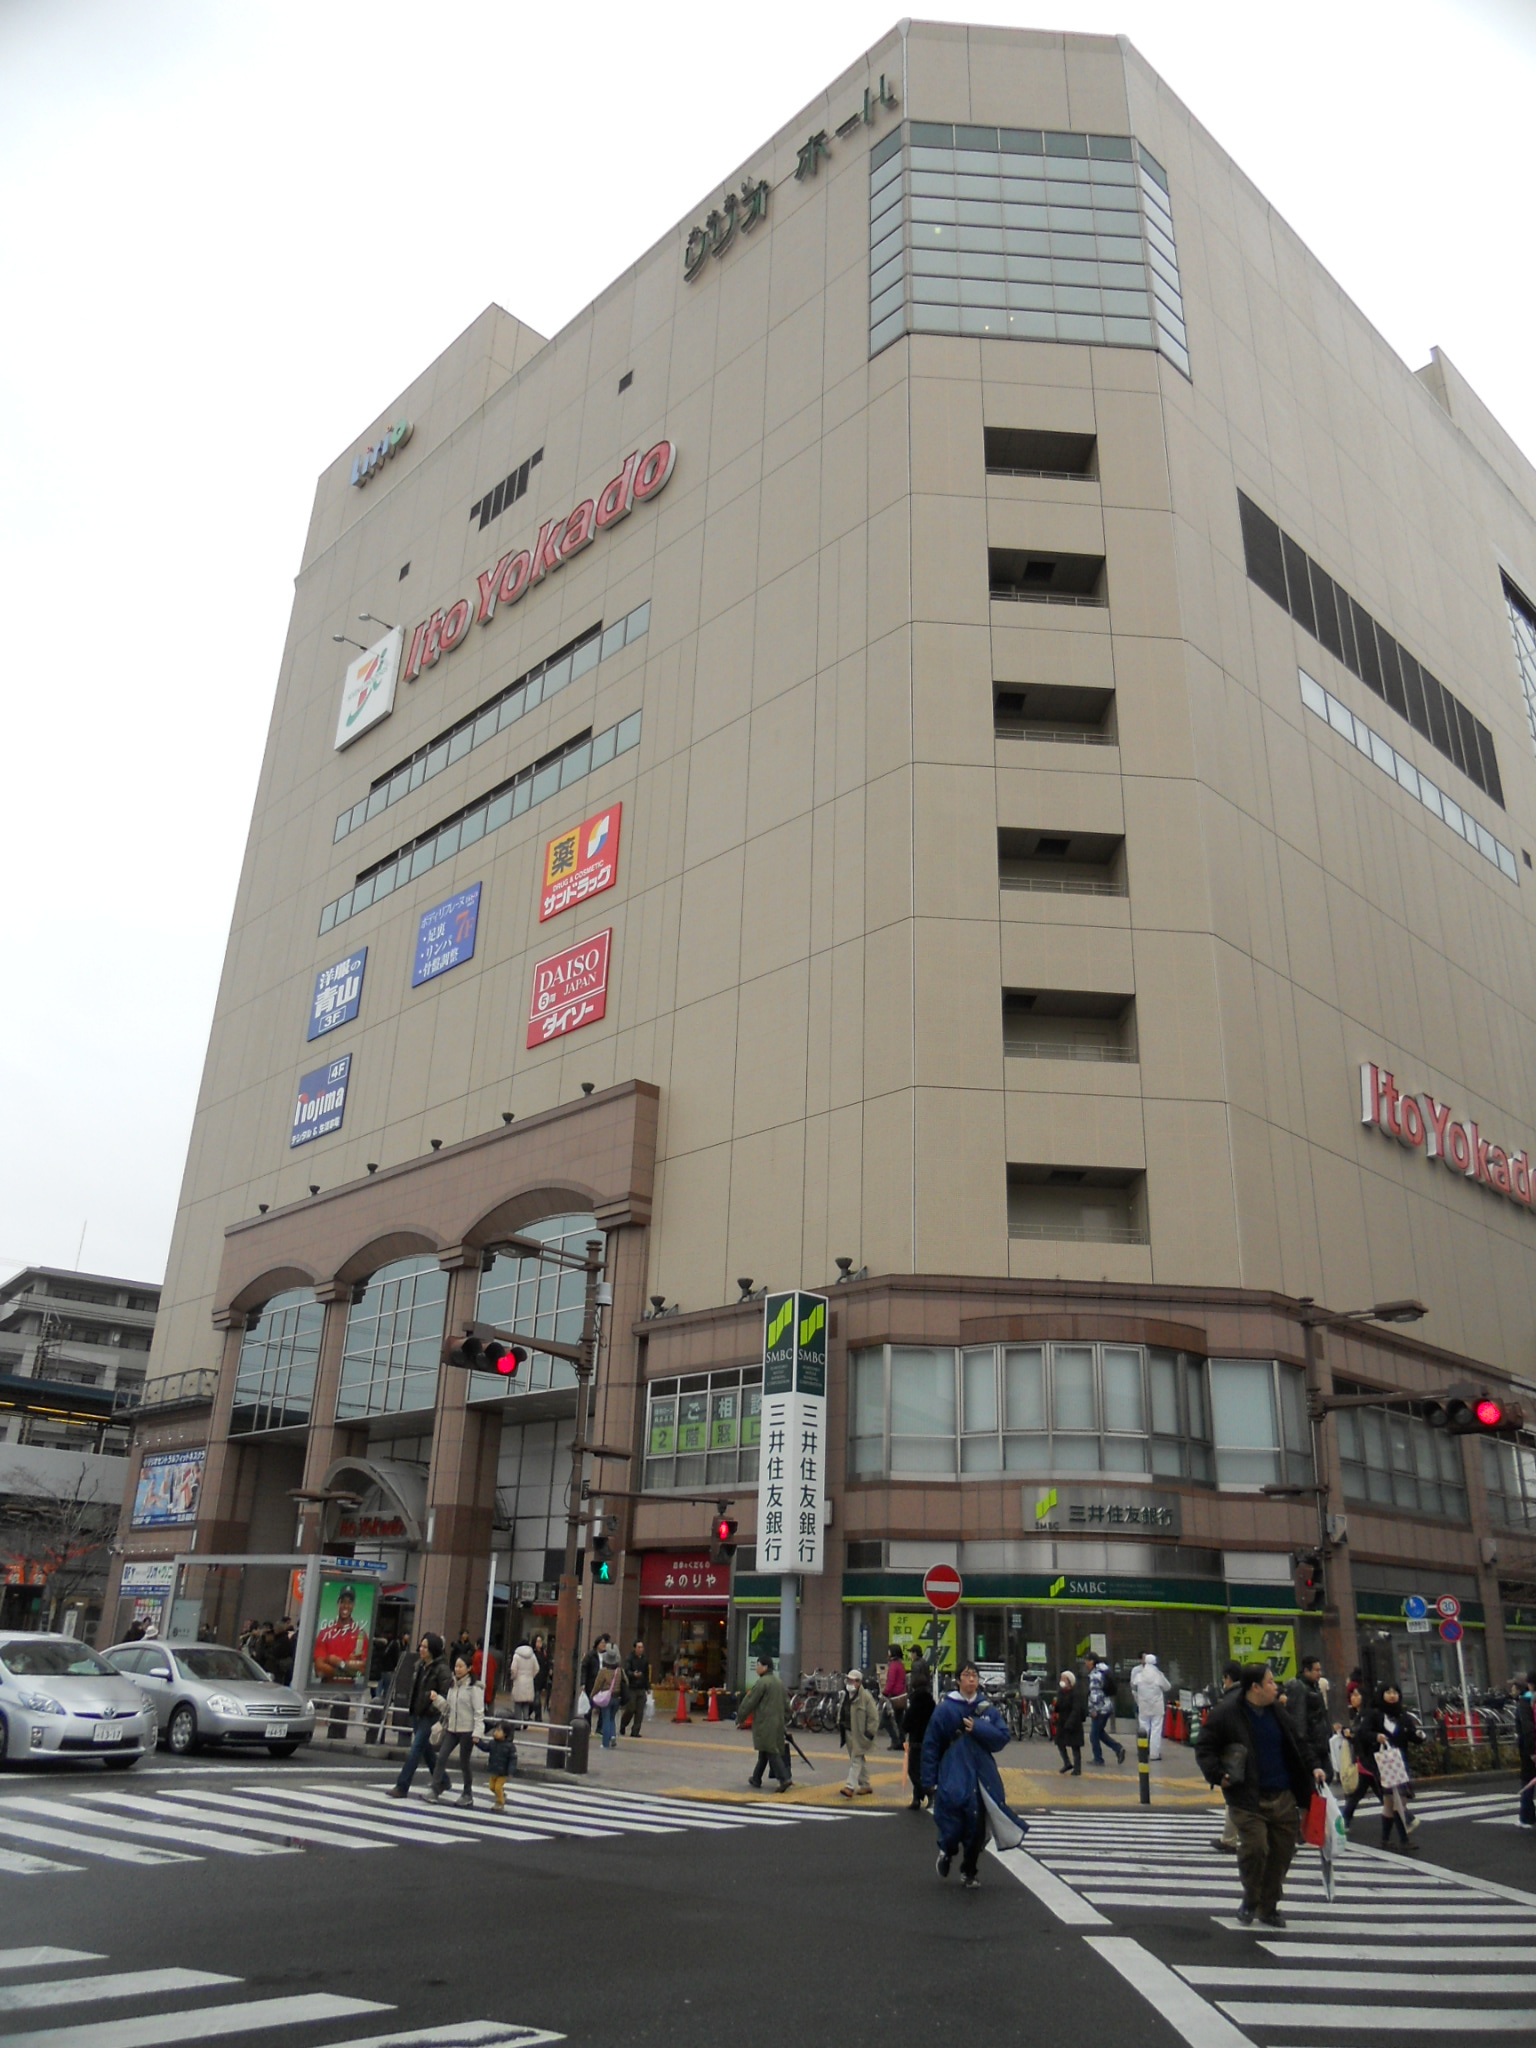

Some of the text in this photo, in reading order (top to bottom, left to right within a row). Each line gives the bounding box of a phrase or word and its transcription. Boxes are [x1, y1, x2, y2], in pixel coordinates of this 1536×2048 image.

[551, 836, 576, 877] 薬
[552, 879, 569, 892] DRUG
[574, 860, 604, 881] COSMETIC
[544, 864, 612, 915] サンドラッグ
[456, 910, 475, 943] 7F
[426, 935, 453, 960] リンパ
[320, 958, 361, 989] 洋服の
[539, 949, 600, 993] DAISO
[563, 971, 597, 995] JAPAN
[315, 976, 360, 1018] 青山
[324, 1011, 341, 1027] 3F
[542, 1002, 594, 1038] ダイソー
[331, 1062, 345, 1078] 4F
[766, 1348, 793, 1364] SMBC
[798, 1349, 825, 1365] SMBC
[765, 1403, 785, 1562] 三井住友銀行
[798, 1404, 818, 1563] 三井住友銀行
[1035, 1521, 1060, 1530] SMBC
[1069, 1504, 1174, 1527] 三井住友銀行
[664, 1574, 717, 1588] みのりや
[1069, 1581, 1107, 1594] SMBC
[1442, 1601, 1455, 1612] 30
[893, 1626, 912, 1635] 窓口
[897, 1616, 909, 1624] 2F
[1236, 1627, 1247, 1635] 2F
[1233, 1636, 1252, 1645] 窓口
